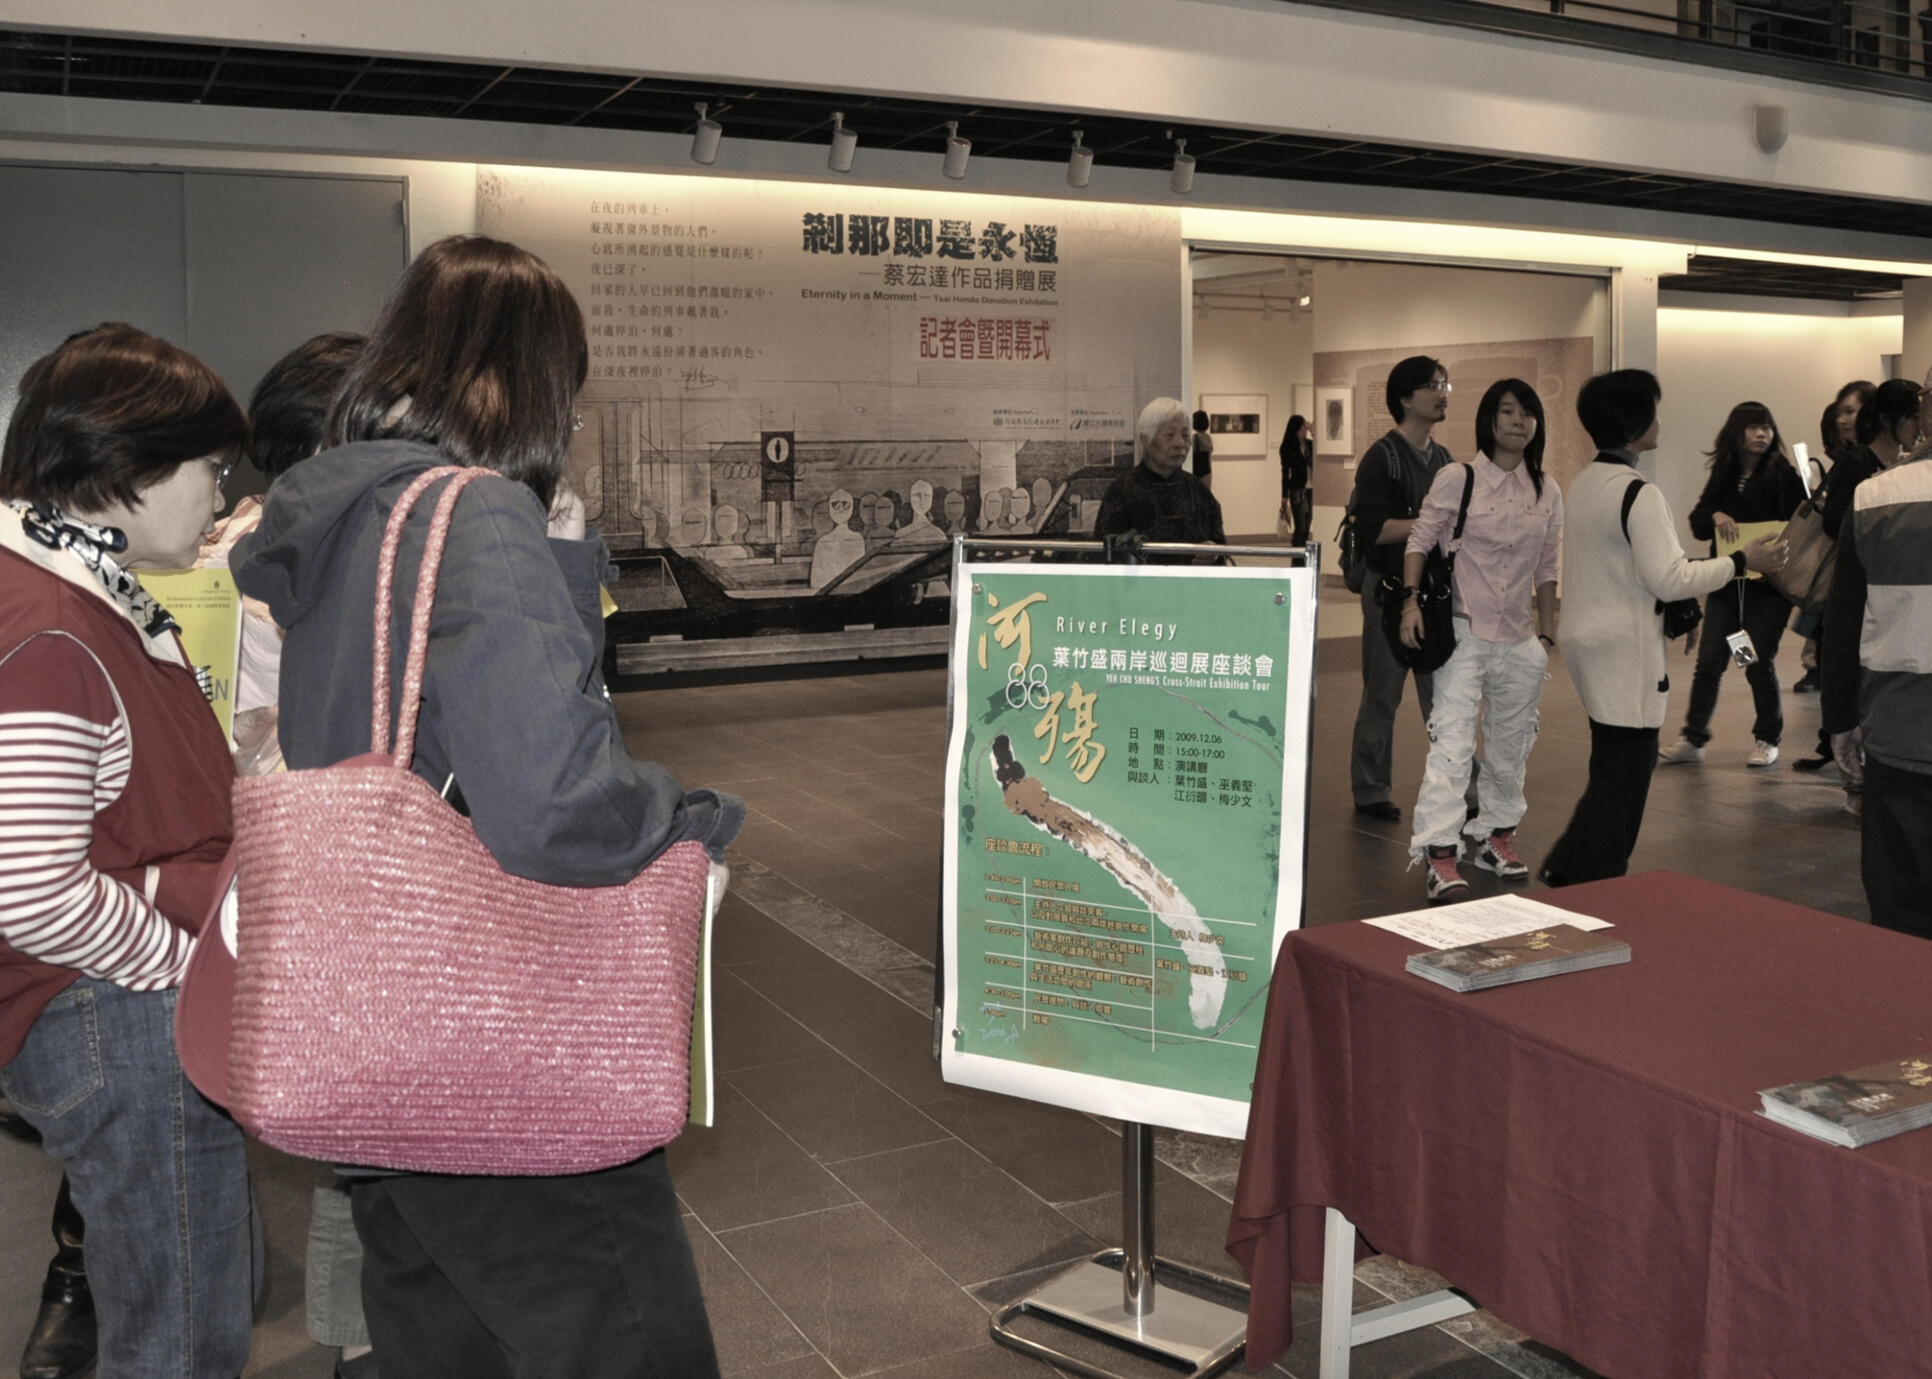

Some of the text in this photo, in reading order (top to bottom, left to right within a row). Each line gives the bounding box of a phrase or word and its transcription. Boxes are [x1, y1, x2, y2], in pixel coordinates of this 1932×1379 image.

[801, 289, 846, 302] Eternity
[850, 291, 860, 300] in
[873, 291, 917, 301] Moment
[981, 296, 1017, 304] Donation
[1019, 297, 1058, 306] Exhibition
[920, 317, 1050, 361] 記者會暨開幕式
[1056, 616, 1177, 640] River Elegy
[1052, 646, 1274, 678] 葉竹盛兩岸巡迴展座談會
[1162, 676, 1207, 688] Cross-Strait
[1209, 677, 1249, 690] Exhibition
[1252, 680, 1271, 691] Tour
[1175, 732, 1222, 744] 2009.12.06
[1176, 746, 1225, 759] 15:00-17:00
